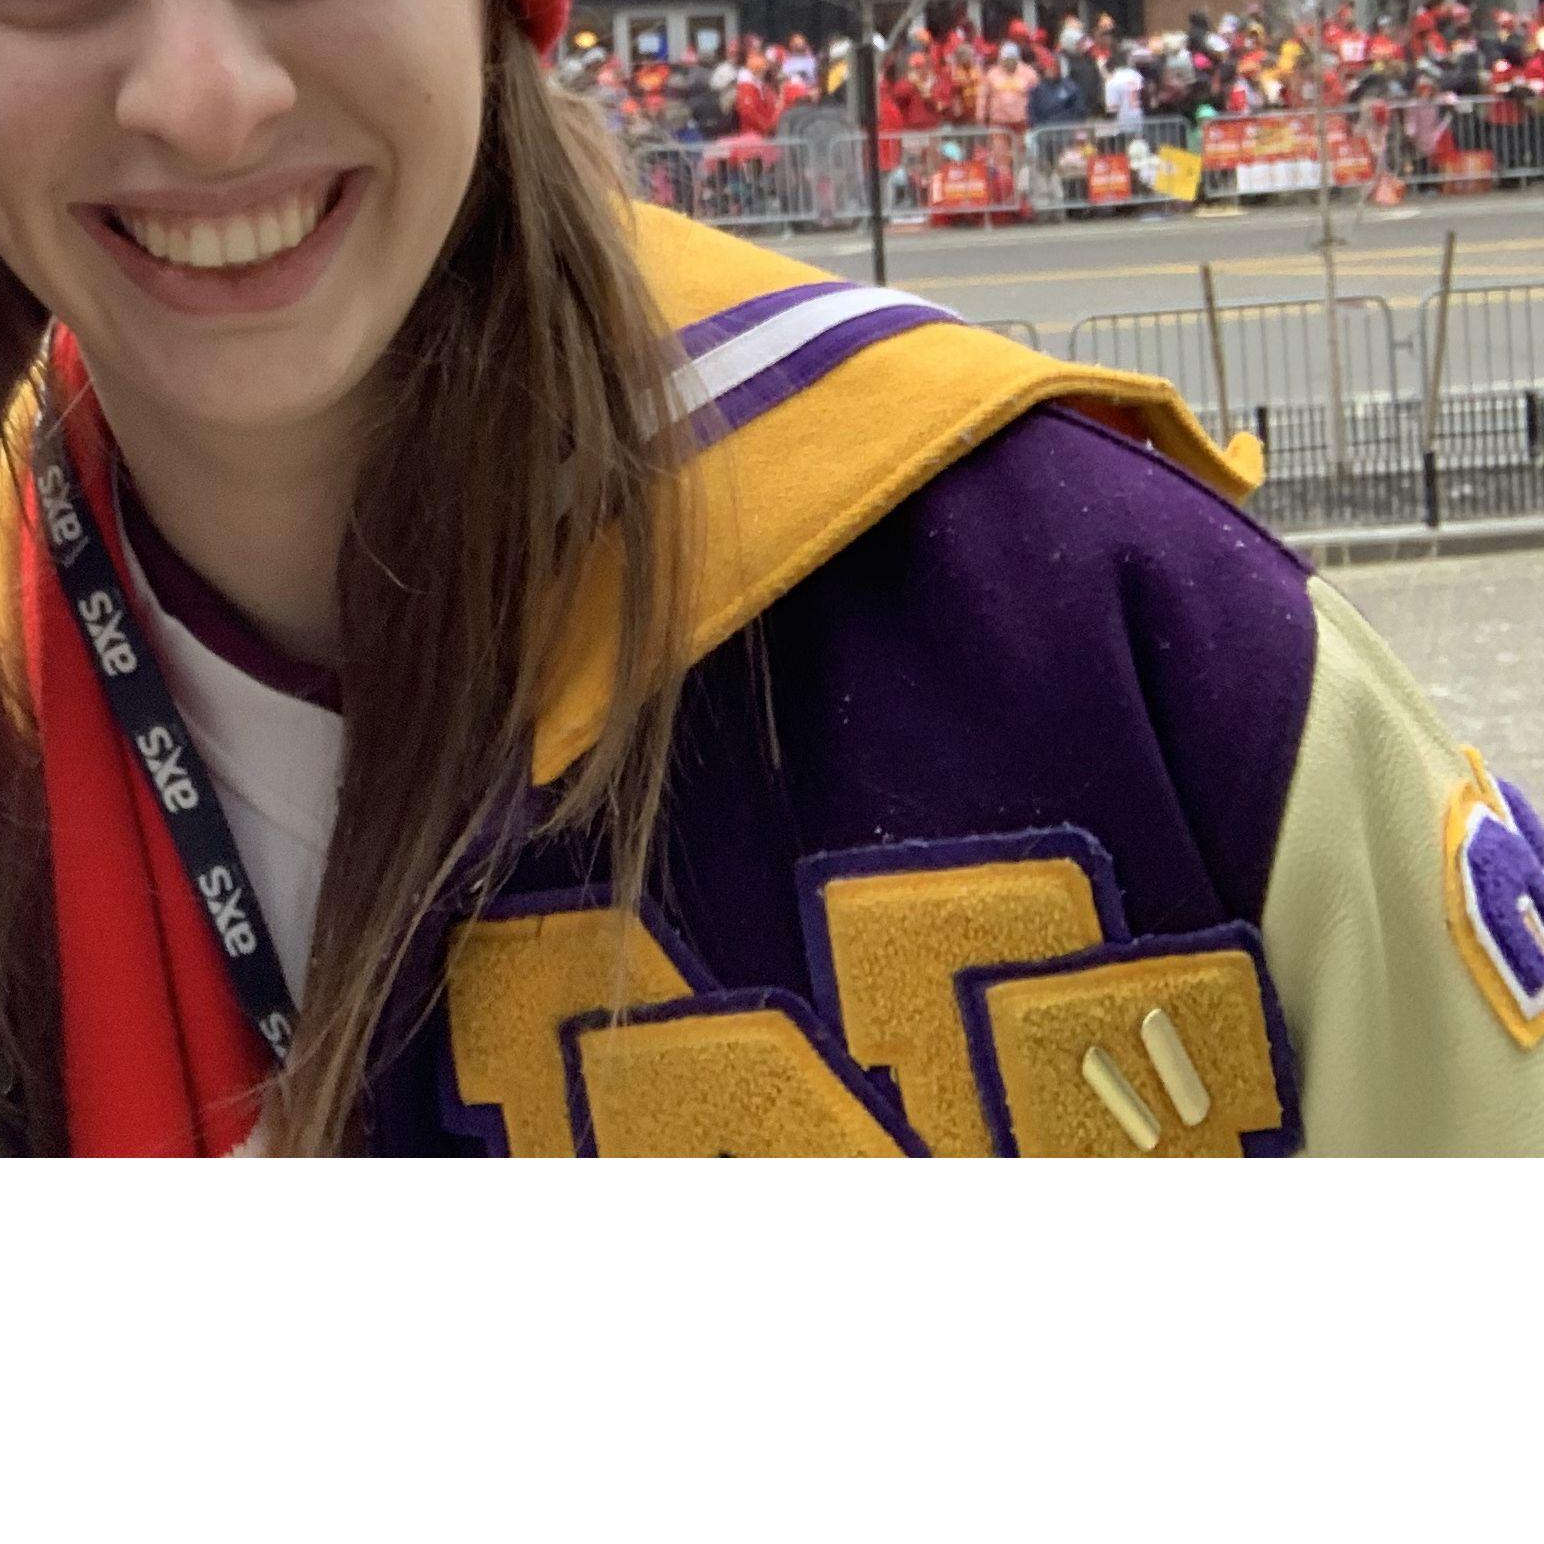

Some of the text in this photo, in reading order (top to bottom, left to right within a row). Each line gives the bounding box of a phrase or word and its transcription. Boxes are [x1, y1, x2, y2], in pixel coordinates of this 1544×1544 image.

[77, 589, 139, 677] axs
[136, 726, 199, 815] axs
[197, 864, 258, 958] axs
